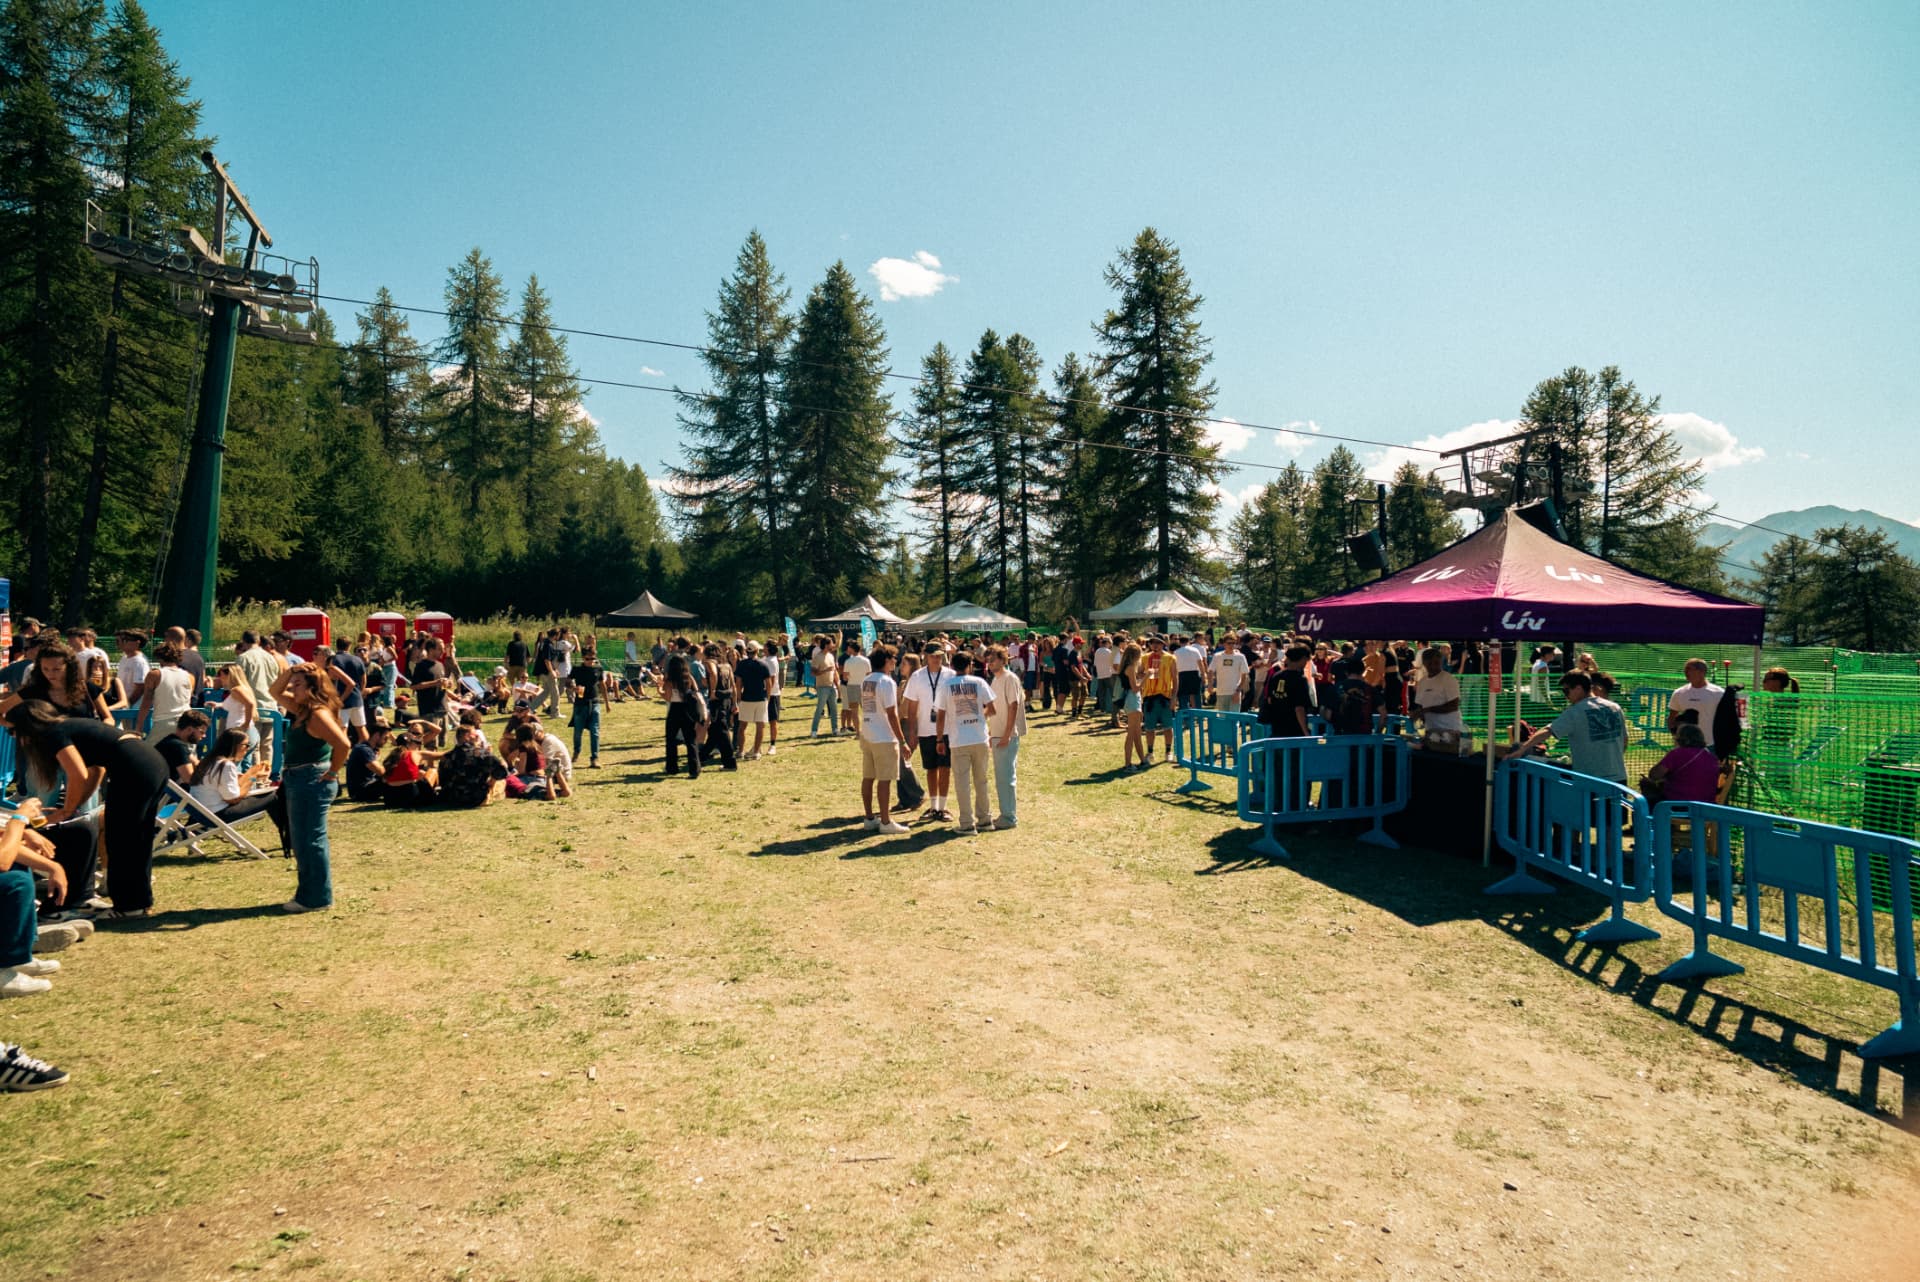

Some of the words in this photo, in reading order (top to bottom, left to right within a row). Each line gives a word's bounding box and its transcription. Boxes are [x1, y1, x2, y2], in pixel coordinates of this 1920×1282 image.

[1411, 565, 1466, 584] Liv
[1544, 565, 1604, 584] Liv
[1298, 613, 1324, 631] Liv
[1501, 610, 1546, 630] Liv
